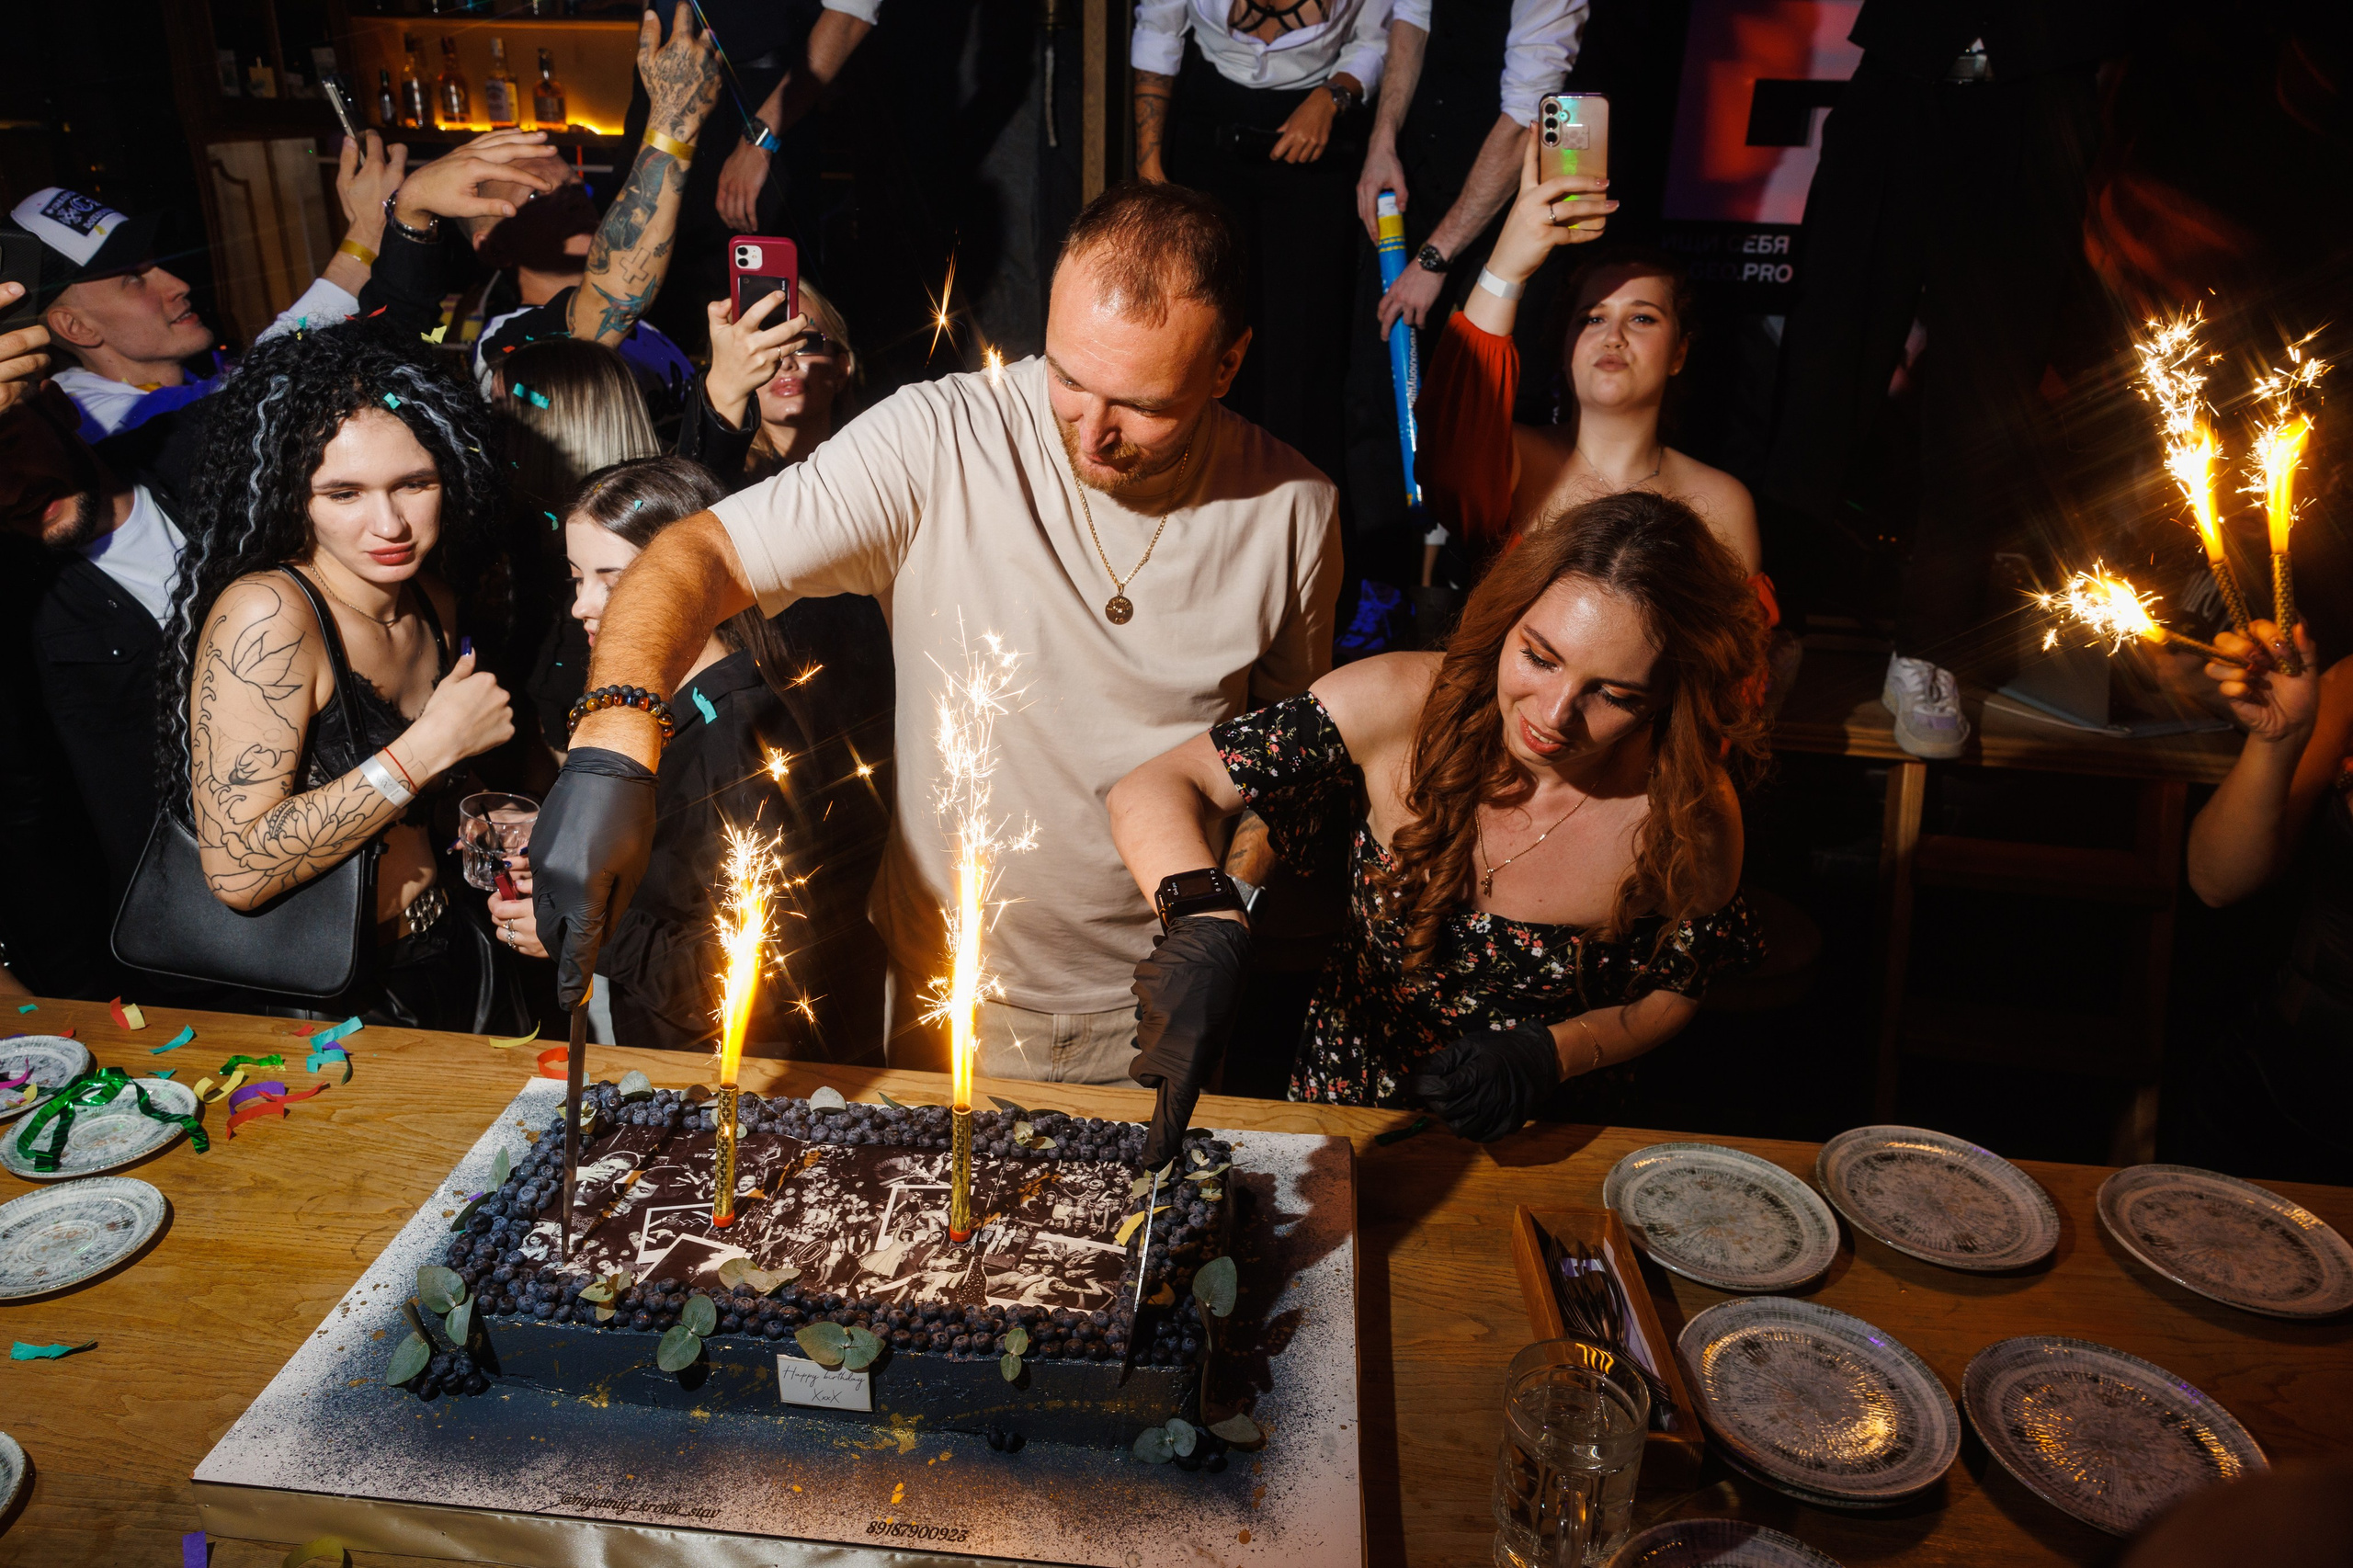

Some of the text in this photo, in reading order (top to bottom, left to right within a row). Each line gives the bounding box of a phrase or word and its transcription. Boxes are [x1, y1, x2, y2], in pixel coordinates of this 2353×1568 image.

[1728, 234, 1790, 255] СЕБЯ
[782, 1365, 865, 1391] Happy birthday
[865, 1521, 970, 1543] 89187900923
